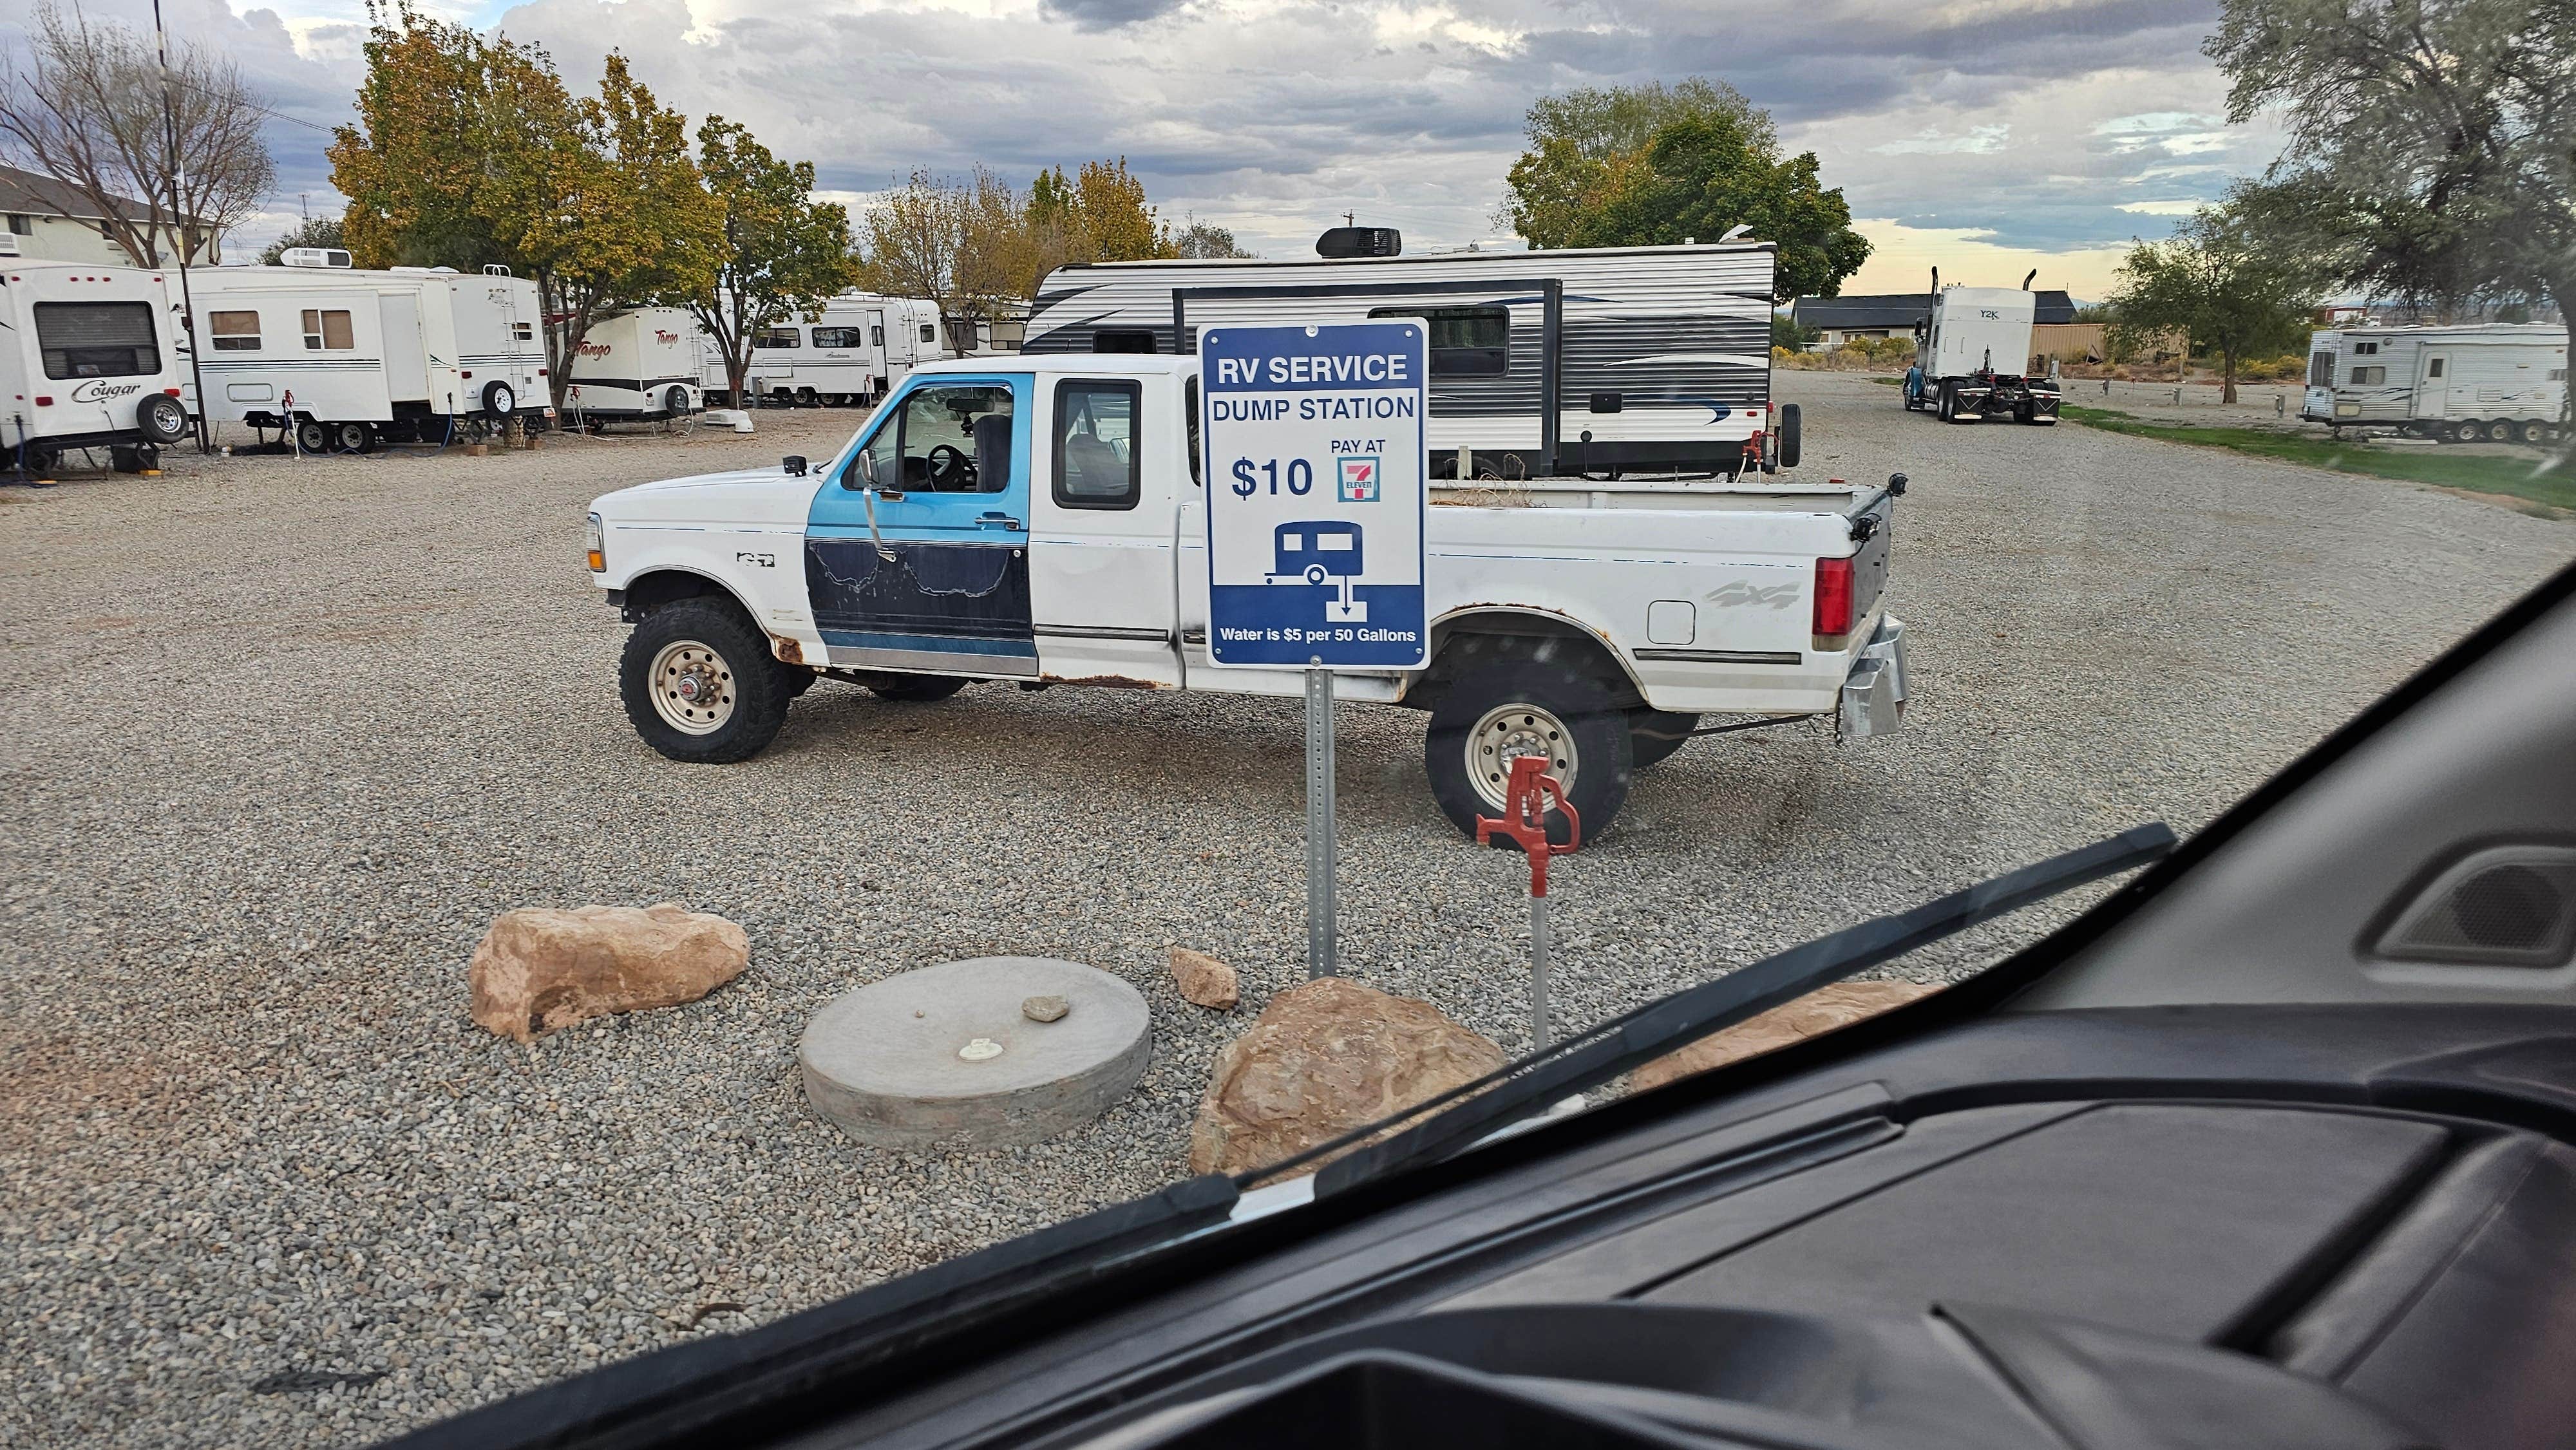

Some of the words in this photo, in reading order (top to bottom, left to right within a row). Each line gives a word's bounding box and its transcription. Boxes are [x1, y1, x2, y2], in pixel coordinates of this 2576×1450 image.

[1980, 310, 1999, 320] Y2K
[655, 330, 678, 349] Tango
[1218, 358, 1260, 384] RV
[1269, 354, 1408, 383] SERVICE
[71, 380, 141, 403] Cougar
[1213, 399, 1289, 421] DUMP
[1300, 397, 1414, 419] STATION
[1331, 440, 1361, 453] PAY
[1365, 439, 1386, 453] AT
[1232, 456, 1312, 501] $10
[1347, 465, 1371, 499] 7
[1220, 628, 1263, 641] Water
[1267, 628, 1280, 641] is
[1283, 628, 1302, 643] $5
[1306, 632, 1331, 643] per
[1334, 628, 1354, 641] 50
[1358, 627, 1416, 641] Gallons
